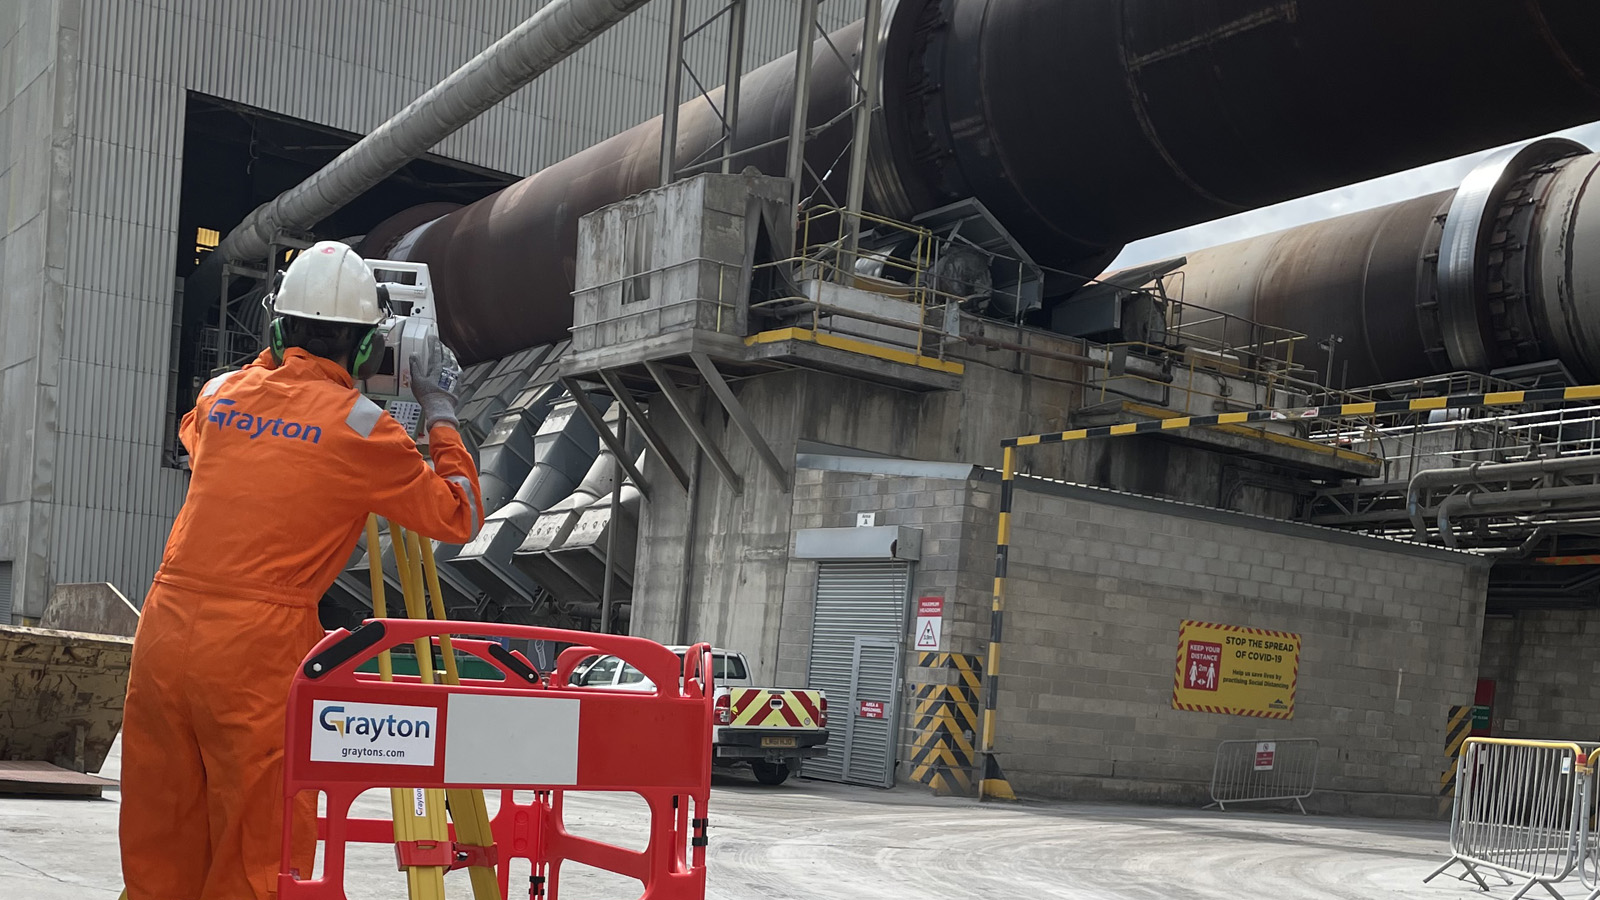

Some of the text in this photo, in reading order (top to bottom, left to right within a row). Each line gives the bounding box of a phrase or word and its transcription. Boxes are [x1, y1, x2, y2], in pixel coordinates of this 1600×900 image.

[208, 398, 322, 444] Grayton
[1226, 636, 1294, 652] STOP THE SPREAD
[1191, 653, 1218, 661] DISTANCE
[1248, 652, 1282, 663] COVID-19
[1198, 664, 1207, 672] 2m
[1264, 680, 1289, 689] Distancing
[320, 706, 430, 742] Grayton
[342, 747, 405, 758] graytons.com
[416, 788, 424, 815] Grayton
